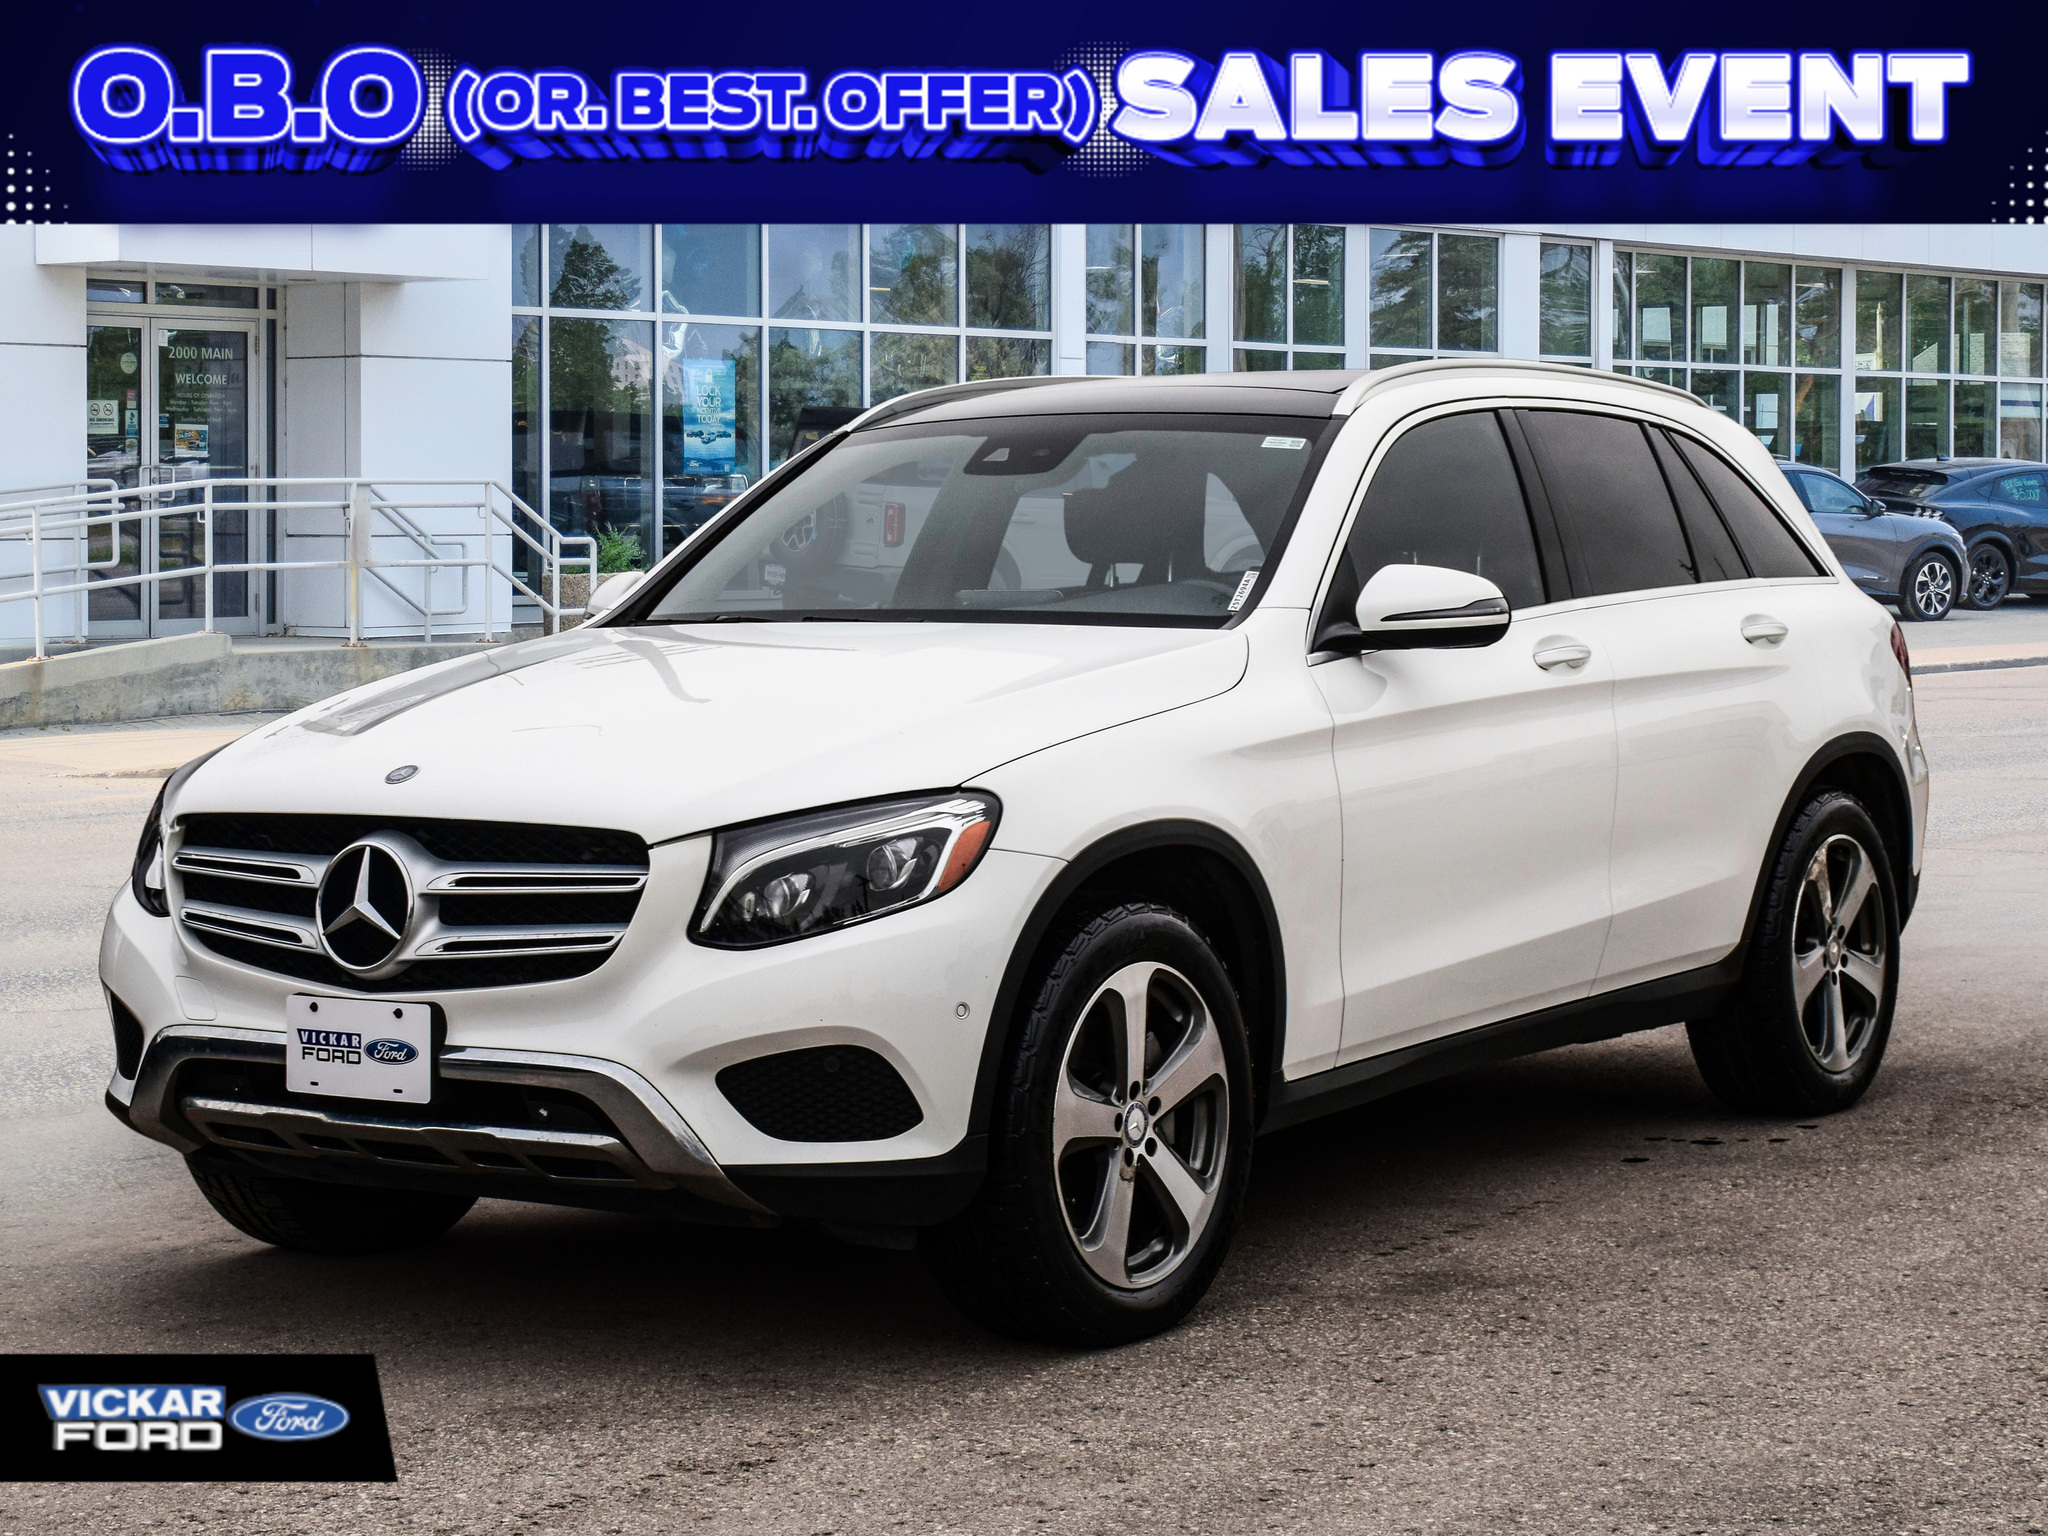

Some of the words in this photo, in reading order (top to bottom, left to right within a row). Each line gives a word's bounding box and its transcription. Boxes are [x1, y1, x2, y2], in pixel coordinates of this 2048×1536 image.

[168, 346, 198, 359] 2000
[201, 347, 233, 360] MAIN
[175, 373, 228, 385] WELCOME
[696, 385, 721, 396] LOCK
[697, 397, 722, 407] YOUR
[697, 414, 721, 424] TODAY
[300, 1030, 361, 1048] VICKAR
[302, 1046, 362, 1065] FORD
[373, 1041, 408, 1062] Ford
